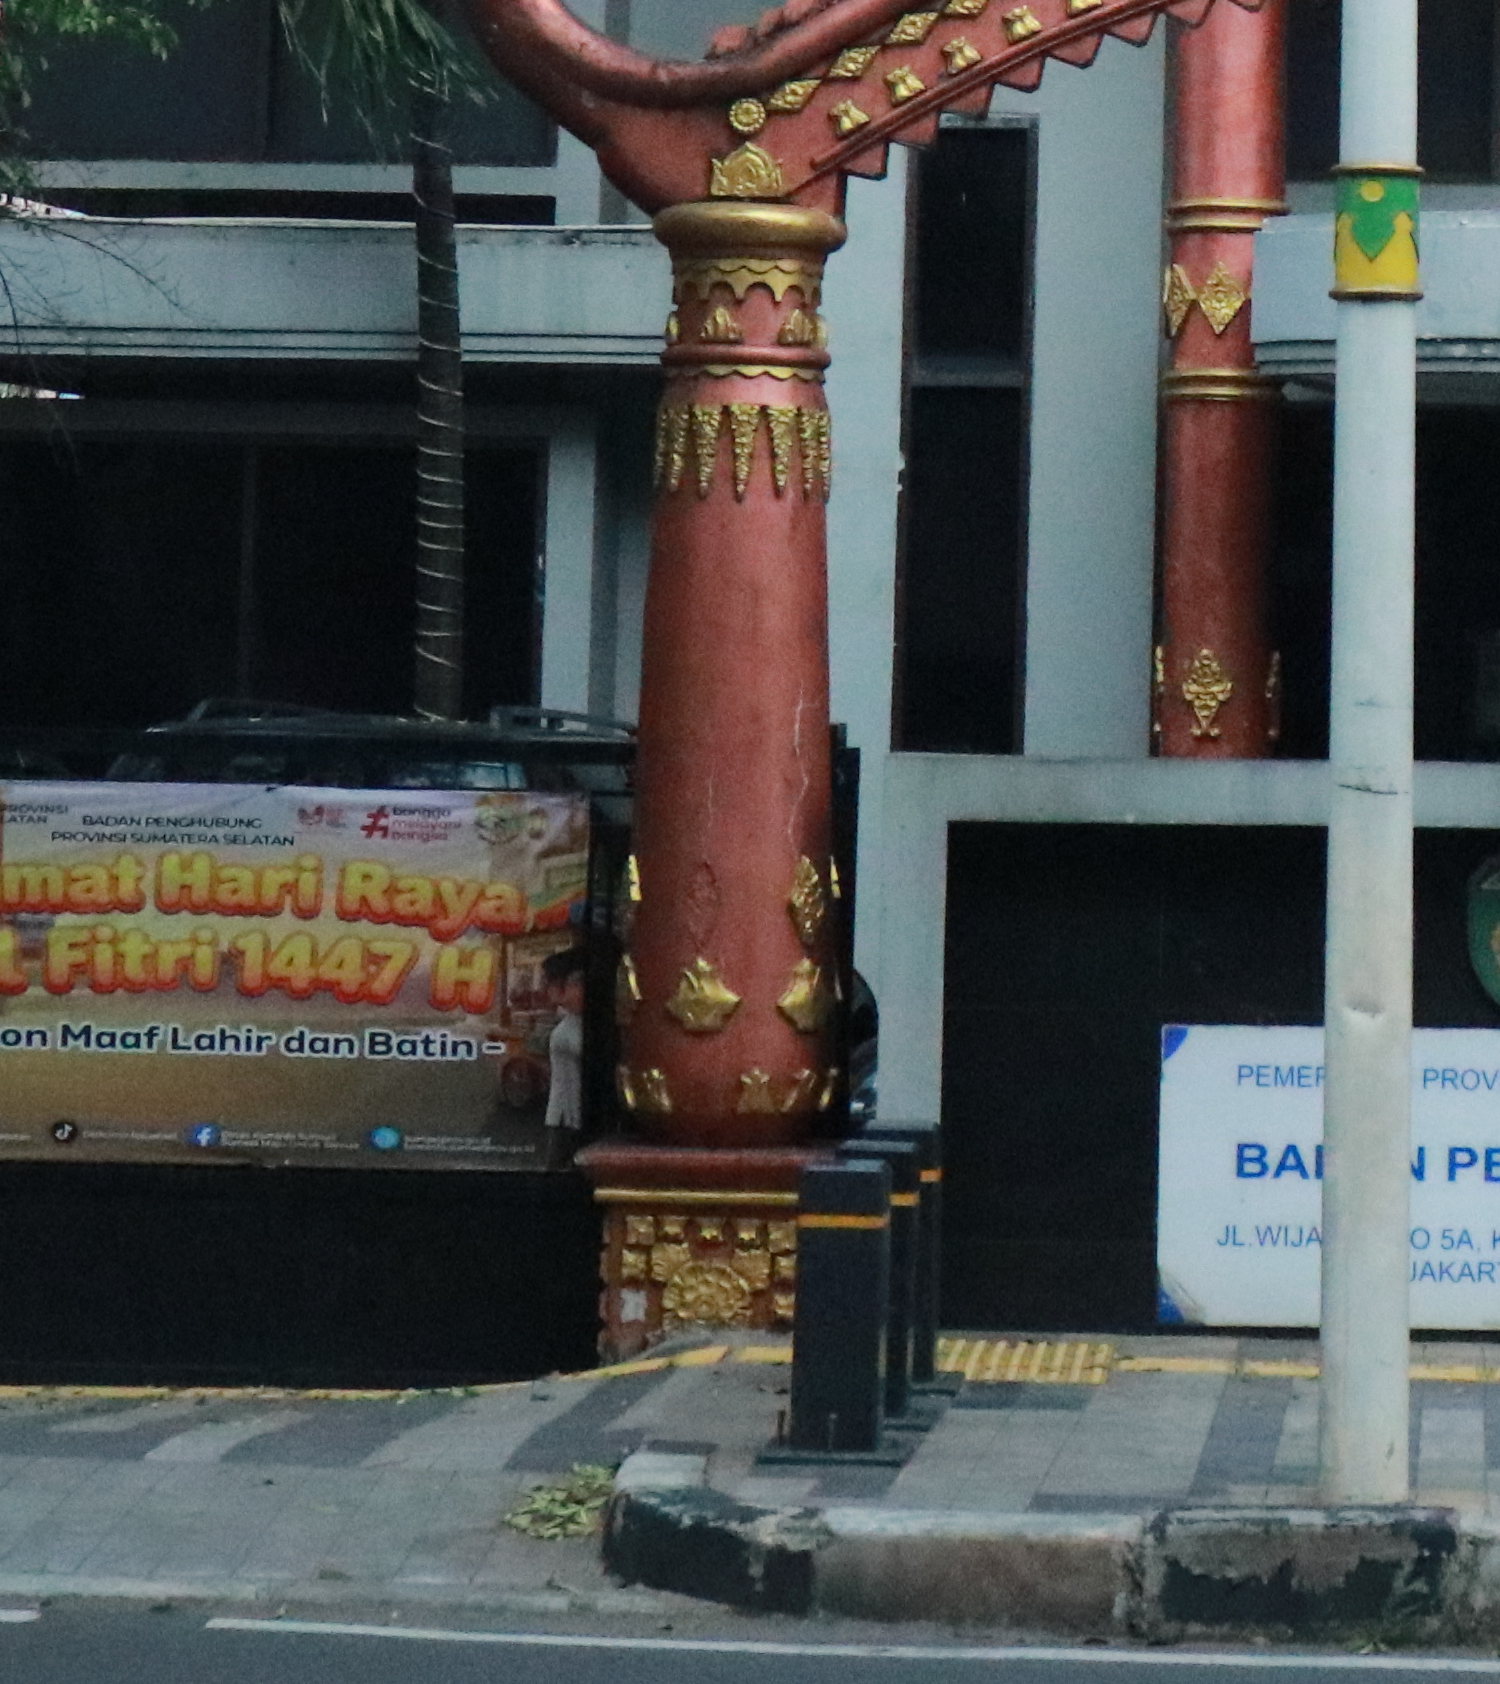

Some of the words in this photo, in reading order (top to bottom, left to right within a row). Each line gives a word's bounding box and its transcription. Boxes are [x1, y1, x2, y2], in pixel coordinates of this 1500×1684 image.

[0, 803, 68, 814] PROVINSI
[392, 806, 451, 819] bangga
[82, 815, 141, 827] BADAN
[145, 817, 263, 829] PENGHUBUNG
[51, 831, 128, 843] PROVINSI
[131, 832, 221, 844] SUMATERA
[223, 833, 295, 846] SELATAN
[391, 830, 449, 842] bangsa
[155, 851, 322, 919] Hari
[336, 862, 526, 941] Raya
[43, 923, 219, 994] Fitri
[232, 931, 418, 1004] 1447
[428, 944, 498, 1015] H
[59, 1023, 161, 1050] Maaf
[170, 1026, 276, 1054] Lahir
[283, 1028, 355, 1055] dan
[367, 1031, 474, 1058] Batin
[1441, 1228, 1481, 1253] 5A,
